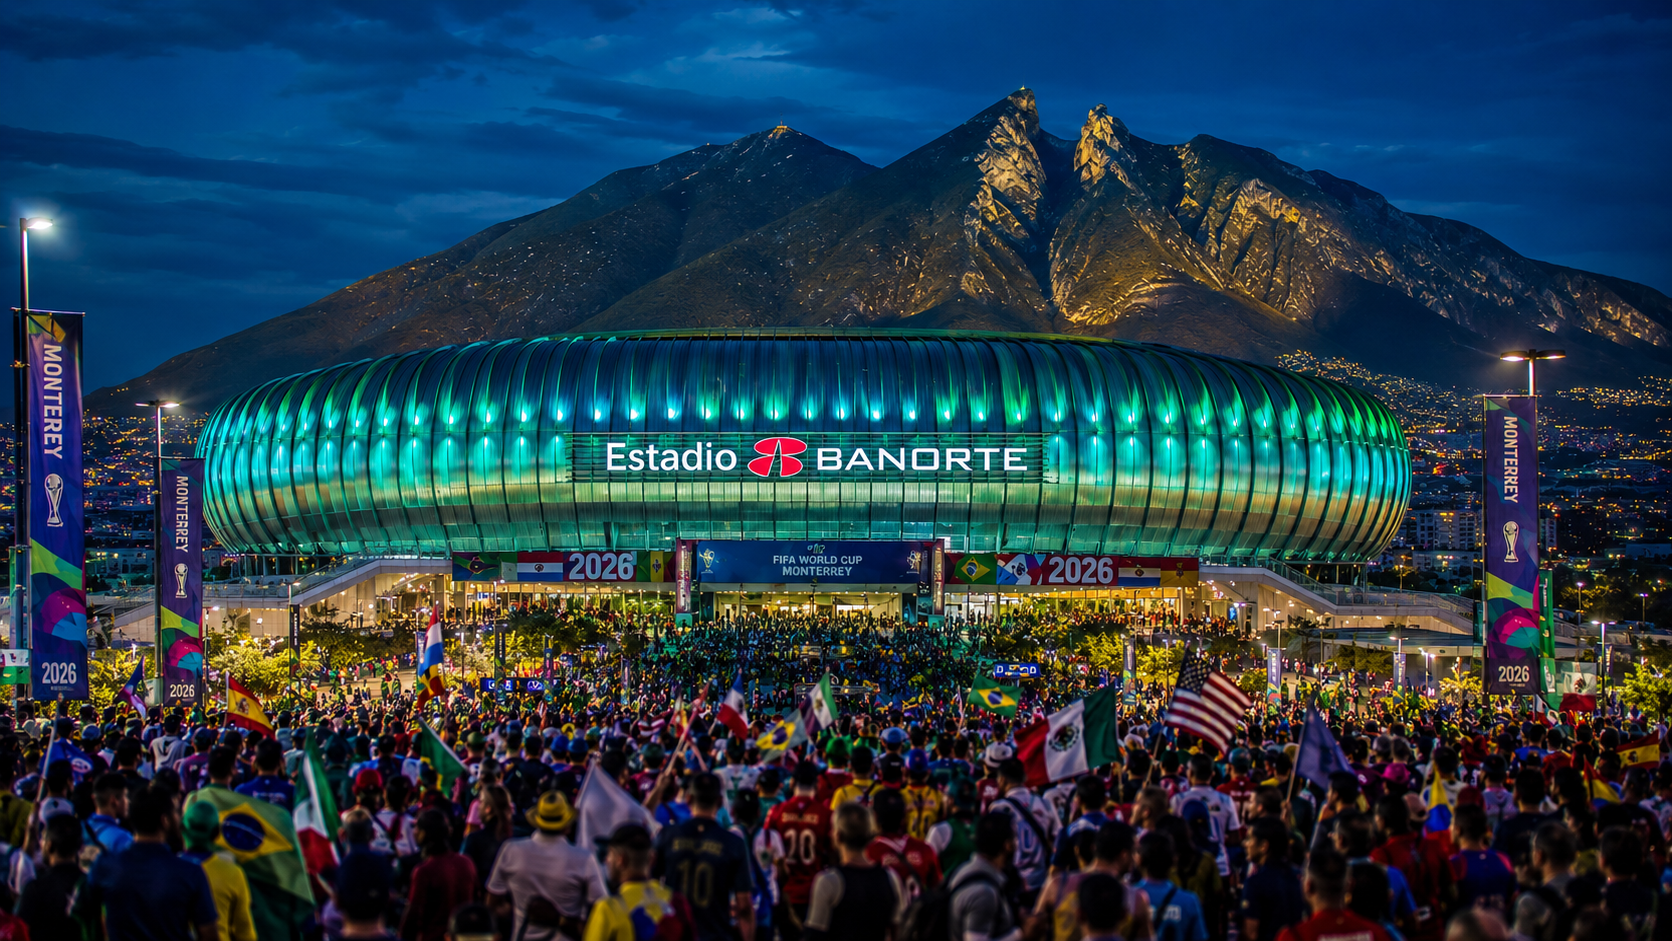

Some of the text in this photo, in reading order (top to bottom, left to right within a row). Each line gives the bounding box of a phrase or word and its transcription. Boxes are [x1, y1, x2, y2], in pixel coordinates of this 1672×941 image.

[43, 343, 63, 459] MONTEREY
[606, 440, 1028, 472] Estadio BANORTE
[1503, 416, 1519, 503] MONTERREY
[175, 475, 189, 553] MONTERREY
[568, 552, 635, 580] 2026
[773, 555, 862, 565] FIFA WORLD CUP
[782, 566, 853, 577] MONTERREY
[1048, 556, 1114, 584] 2026
[41, 661, 77, 685] 2026
[1498, 665, 1530, 683] 2026
[169, 683, 195, 698] 2026
